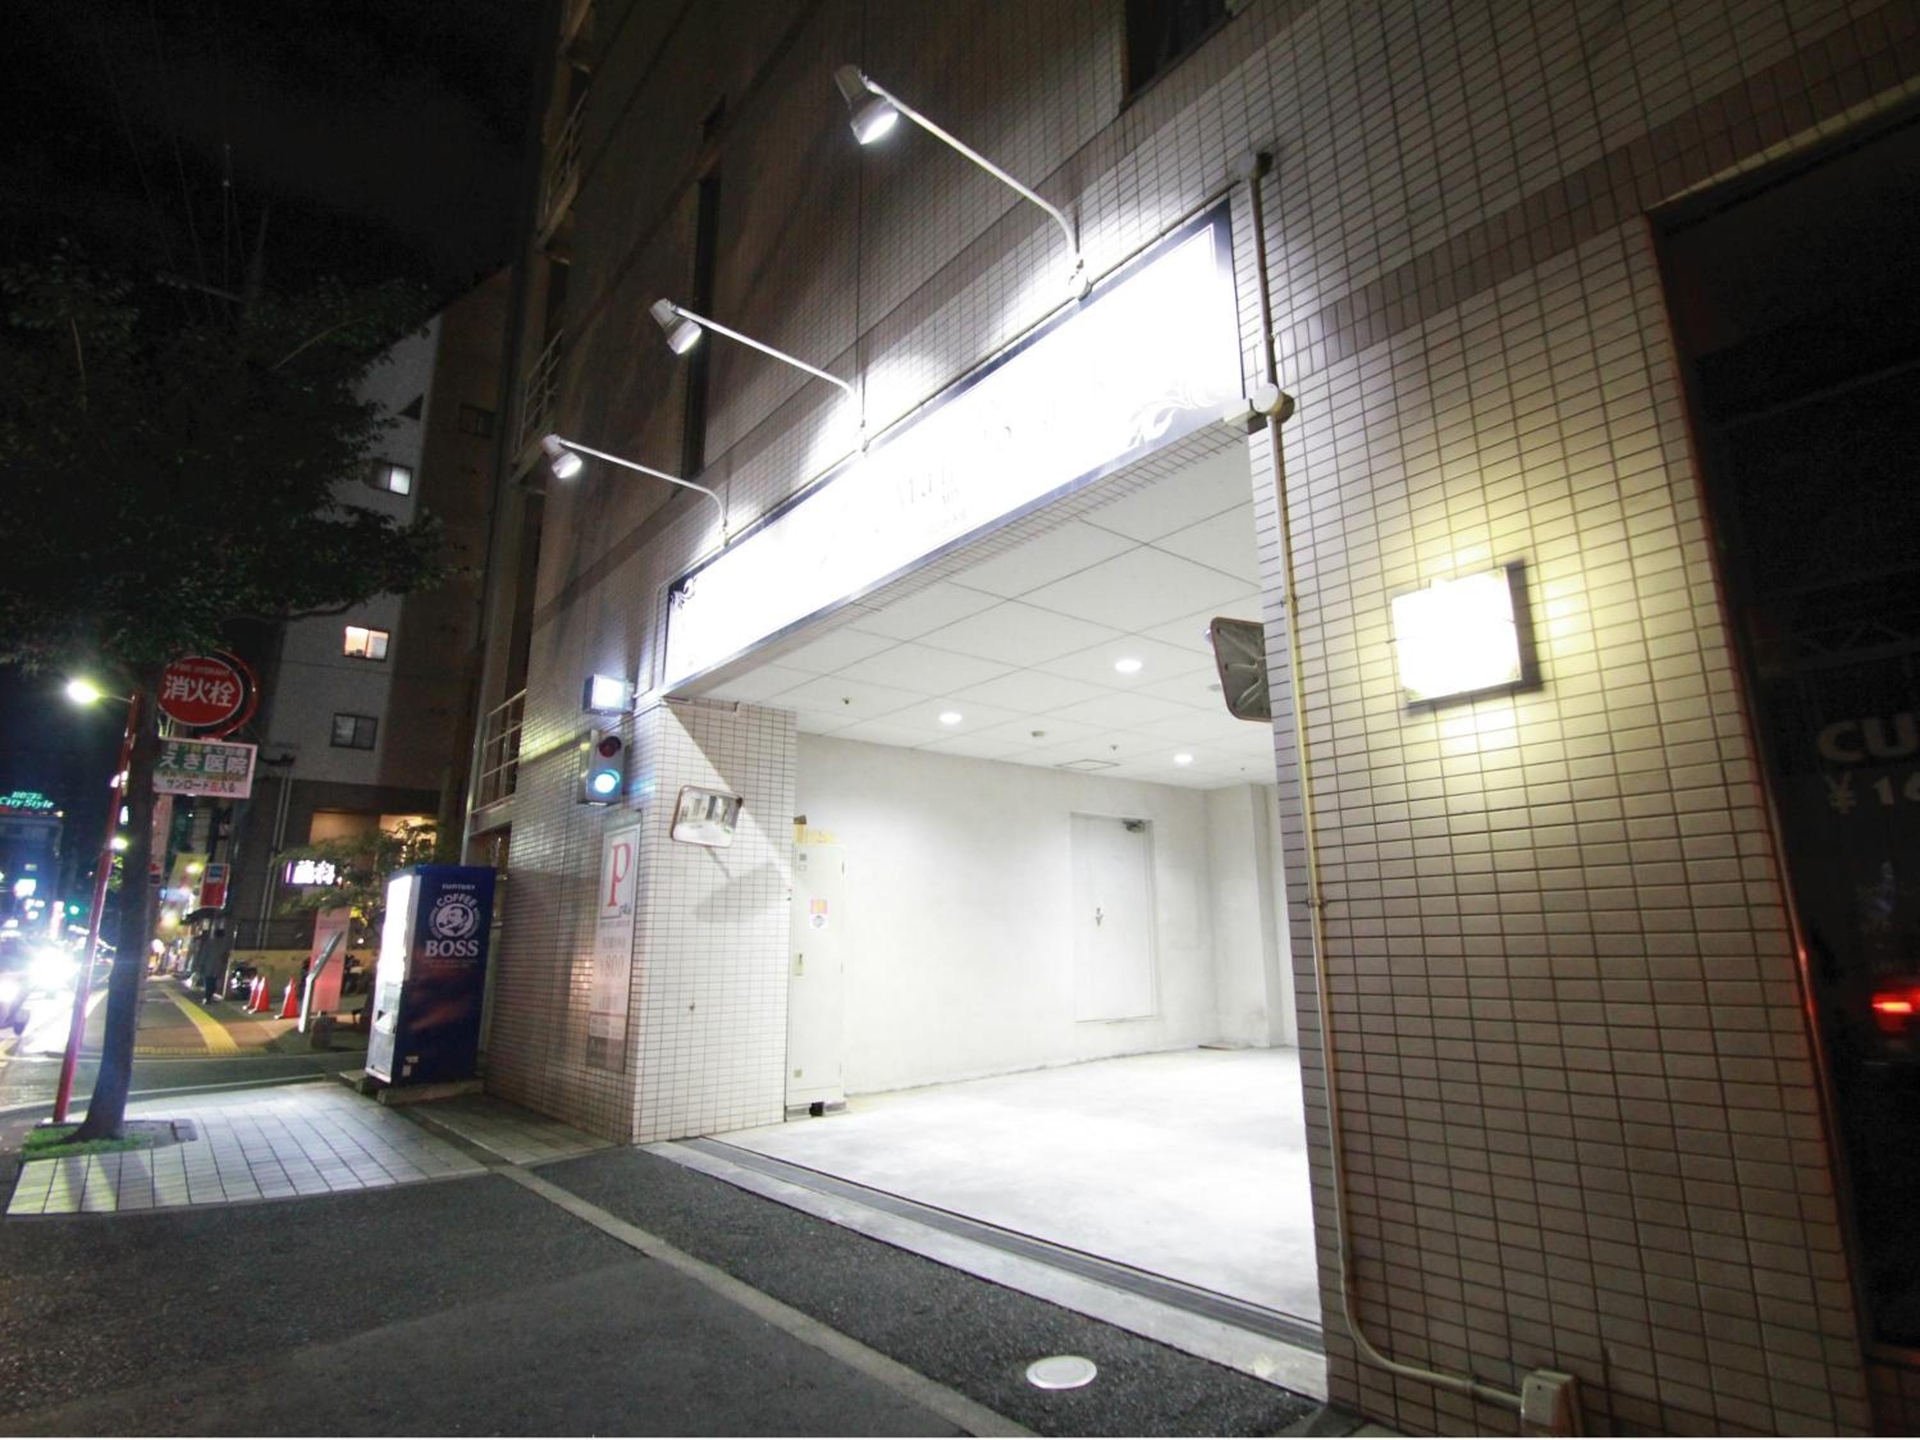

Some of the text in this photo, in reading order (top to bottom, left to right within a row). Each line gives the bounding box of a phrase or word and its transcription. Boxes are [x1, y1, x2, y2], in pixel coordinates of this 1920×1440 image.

[163, 674, 235, 707] 消火栓
[607, 842, 631, 907] P
[436, 893, 478, 908] COFFEE
[425, 939, 479, 957] BOSS
